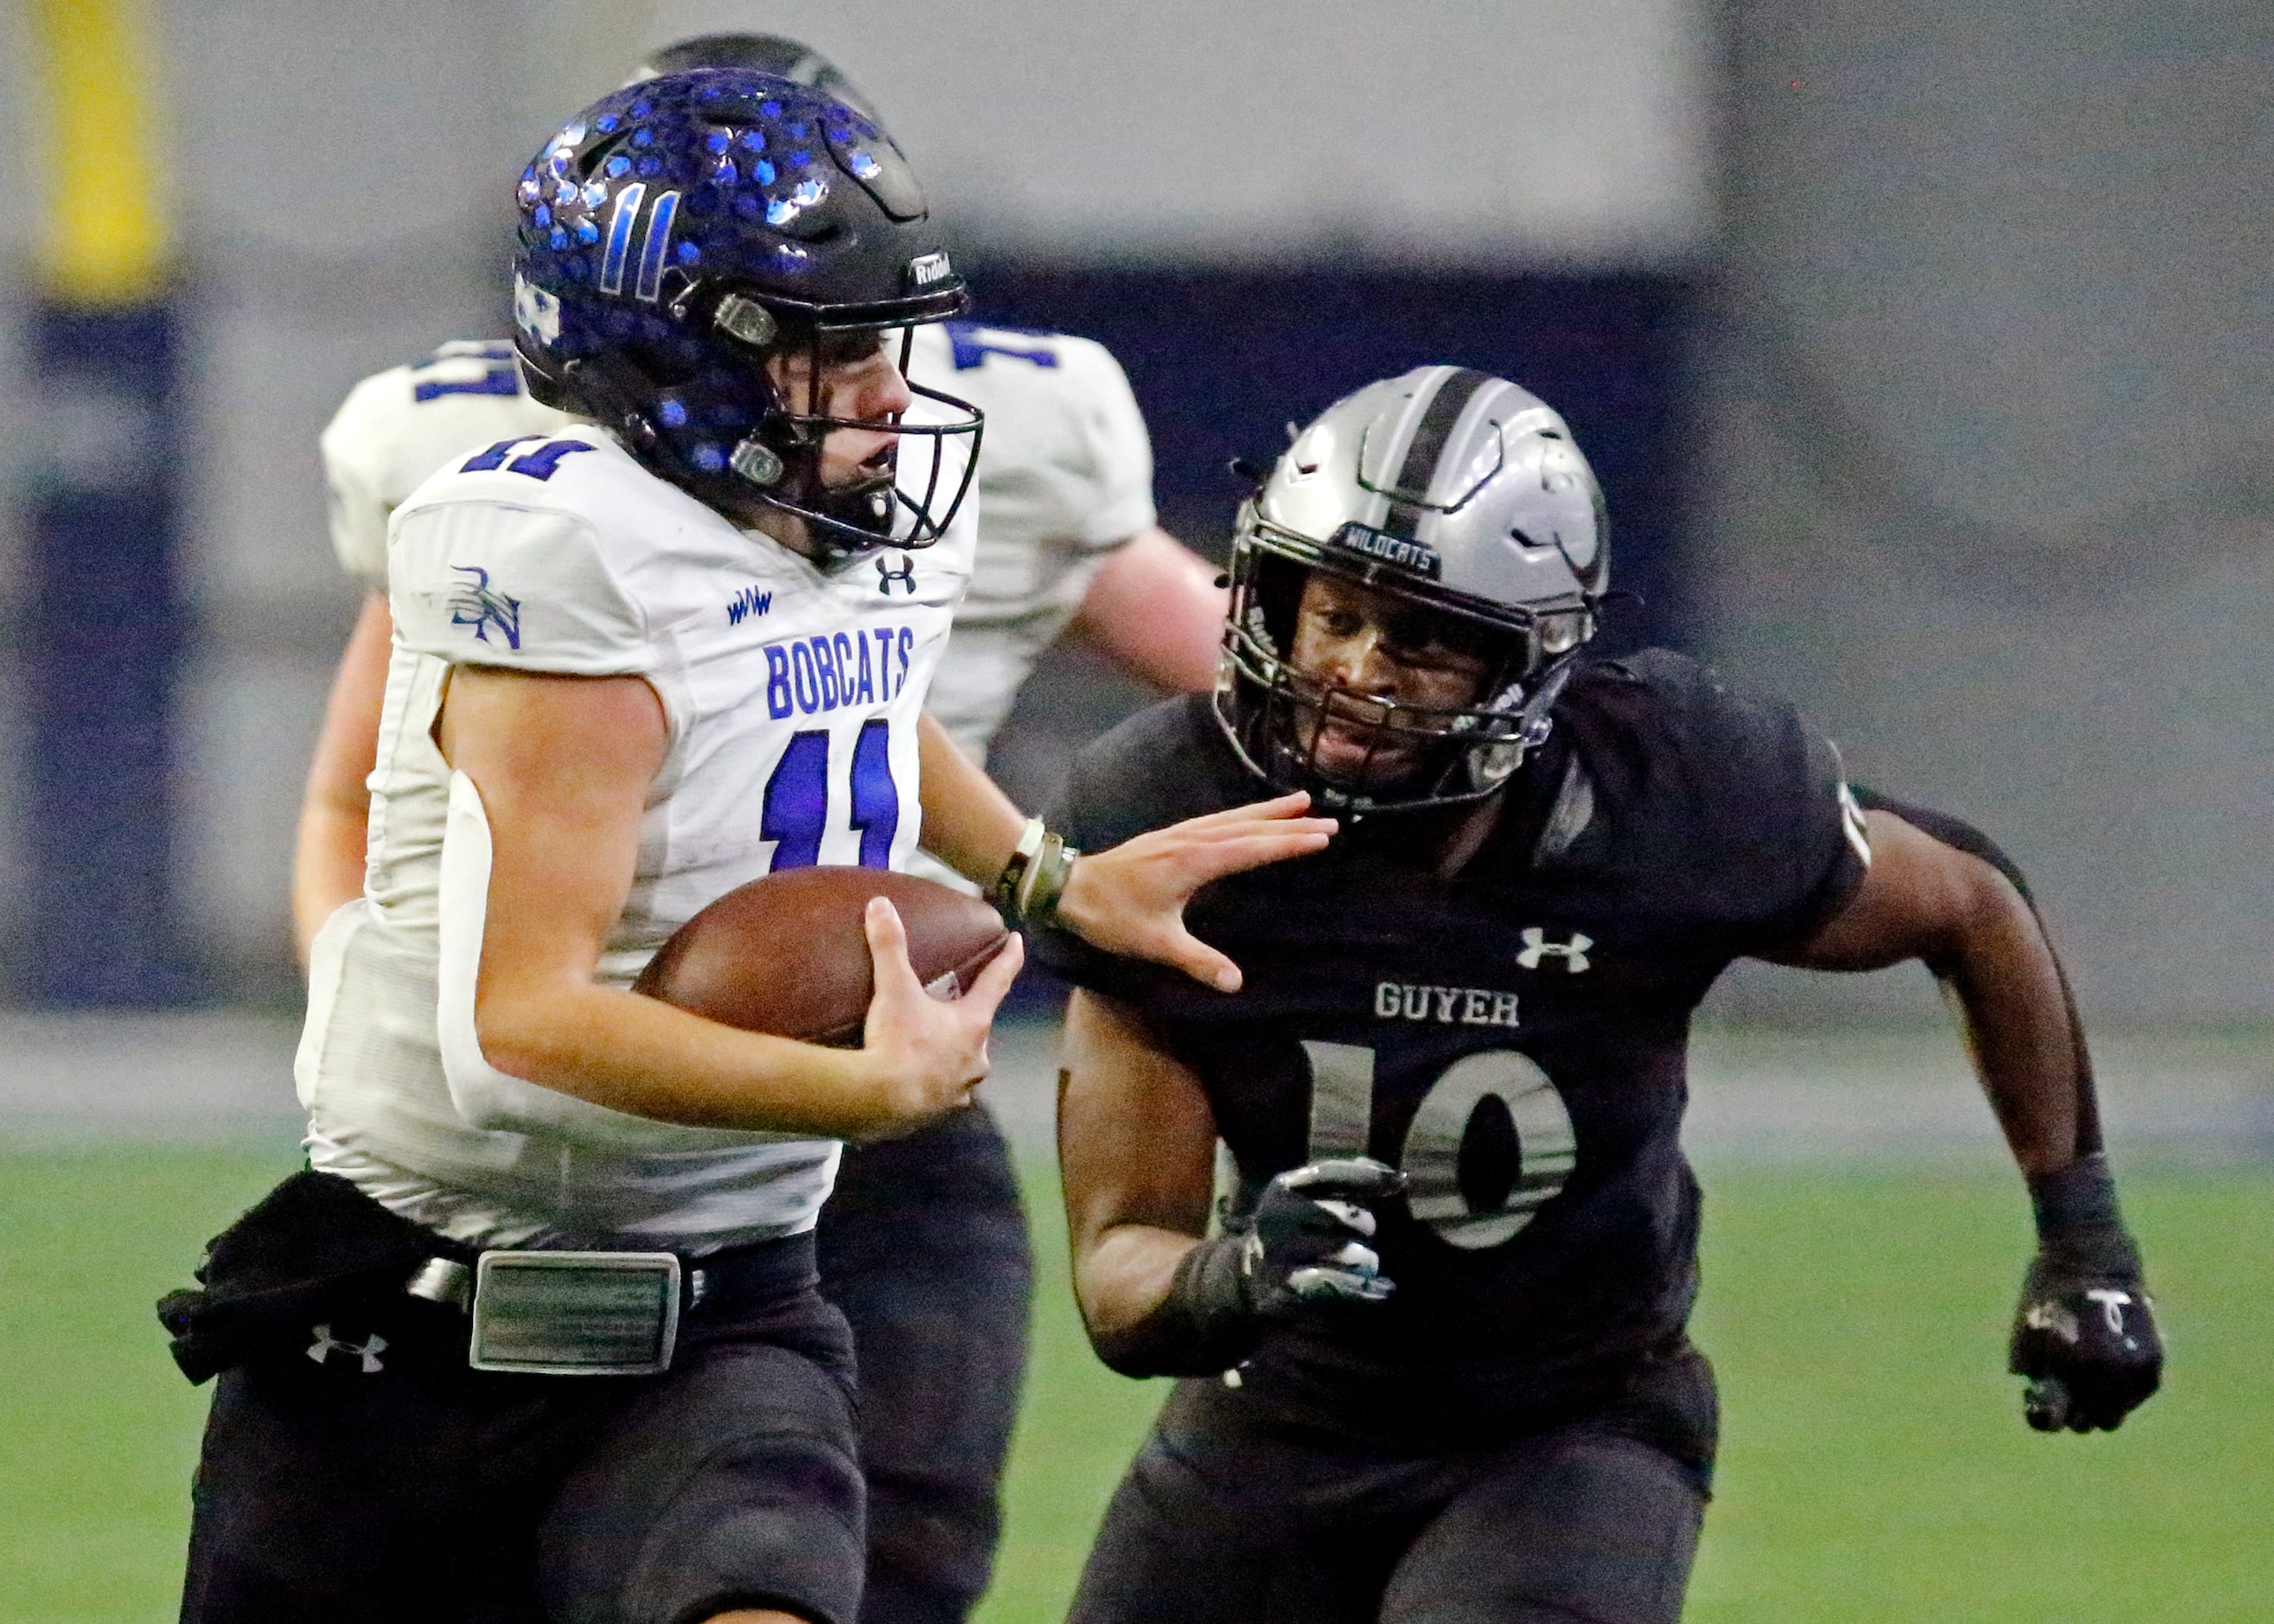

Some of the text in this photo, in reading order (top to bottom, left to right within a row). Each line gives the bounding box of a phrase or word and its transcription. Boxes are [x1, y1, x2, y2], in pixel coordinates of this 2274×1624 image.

[599, 182, 681, 302] 11
[763, 626, 914, 720] BOBCATS
[760, 719, 898, 873] 11
[1375, 981, 1519, 1028] GUYER
[1300, 1040, 1577, 1250] 10
